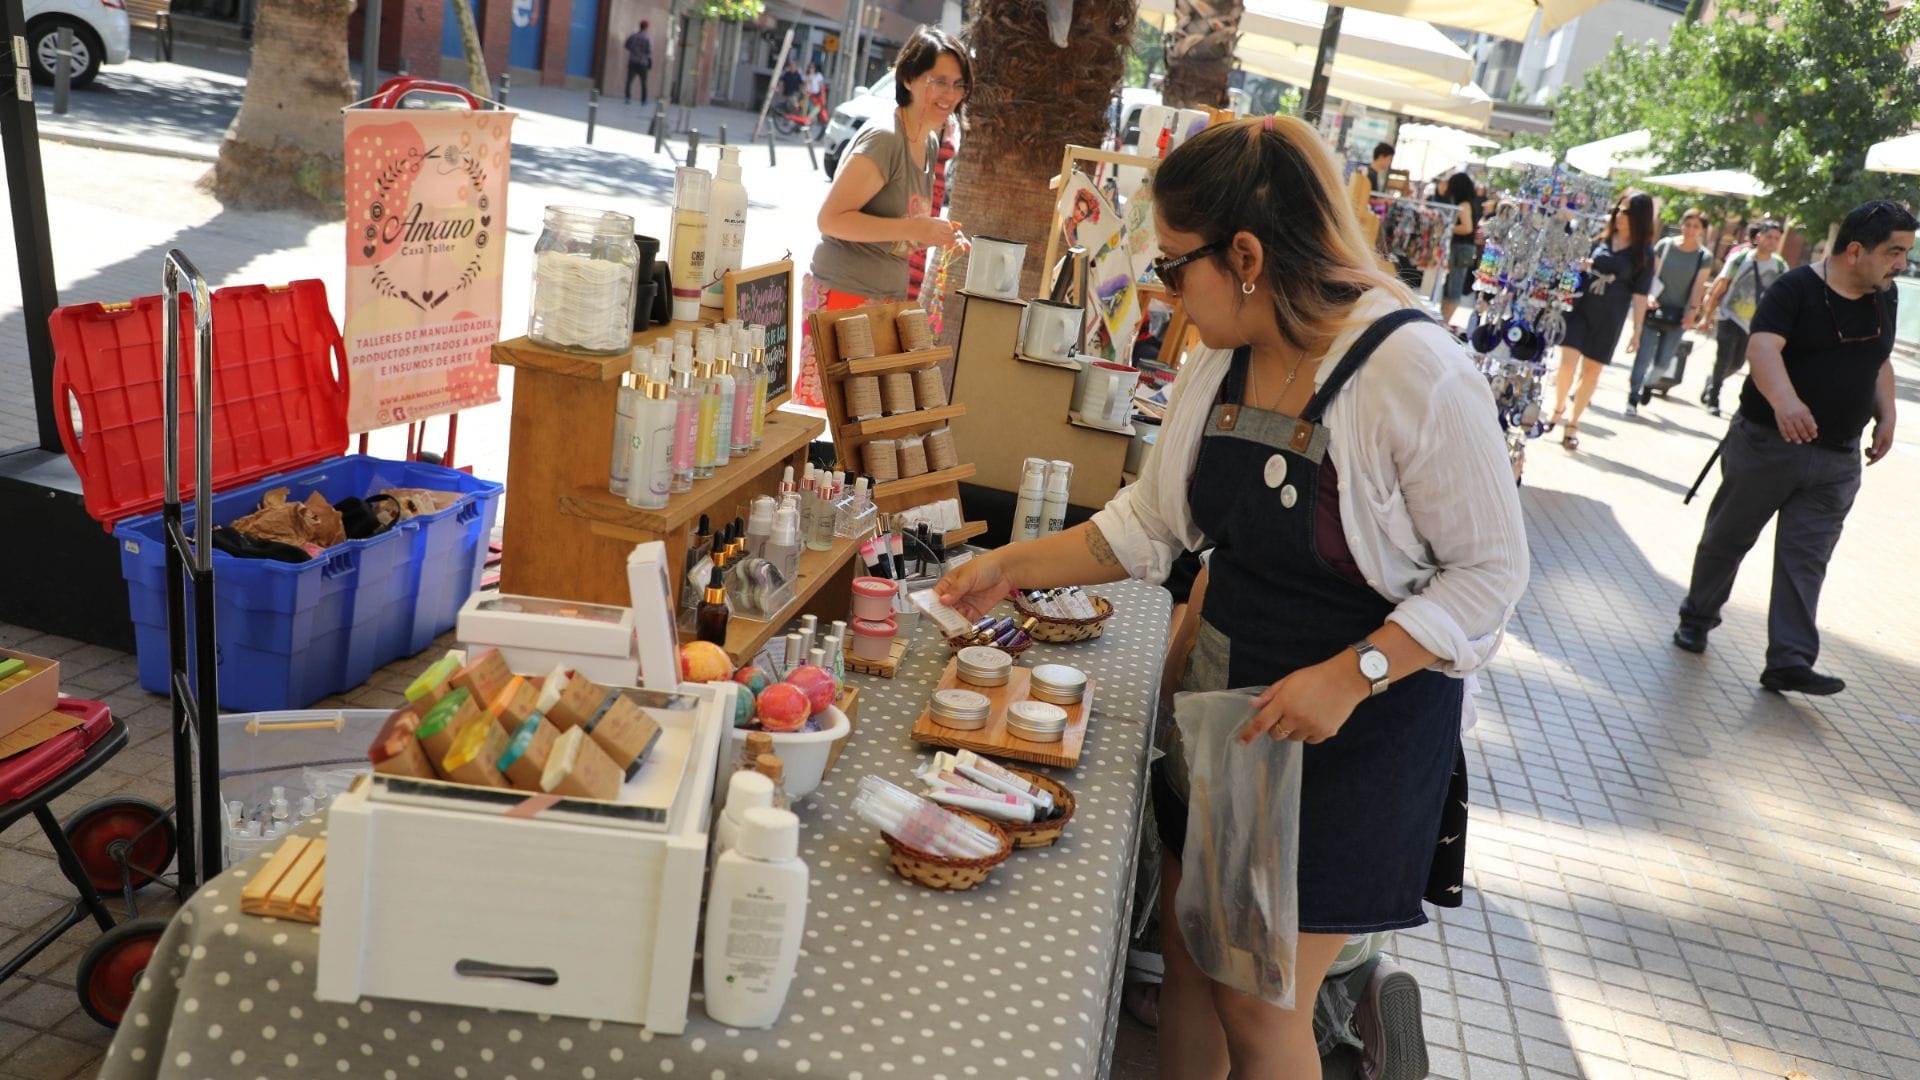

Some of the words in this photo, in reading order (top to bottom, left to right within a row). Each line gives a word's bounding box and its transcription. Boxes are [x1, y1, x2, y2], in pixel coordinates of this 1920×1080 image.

[382, 202, 474, 245] Amano
[401, 246, 424, 256] Casa
[427, 244, 456, 253] Taller
[352, 347, 410, 365] PRODUCTOS
[412, 338, 461, 354] PINTADOS
[463, 337, 469, 347] A
[470, 333, 496, 345] MANO
[356, 332, 402, 349] TALLERES
[404, 330, 417, 341] DE
[381, 365, 387, 376] E
[388, 357, 434, 374] INSUMOS
[435, 355, 447, 366] DE
[450, 352, 473, 364] ARTE
